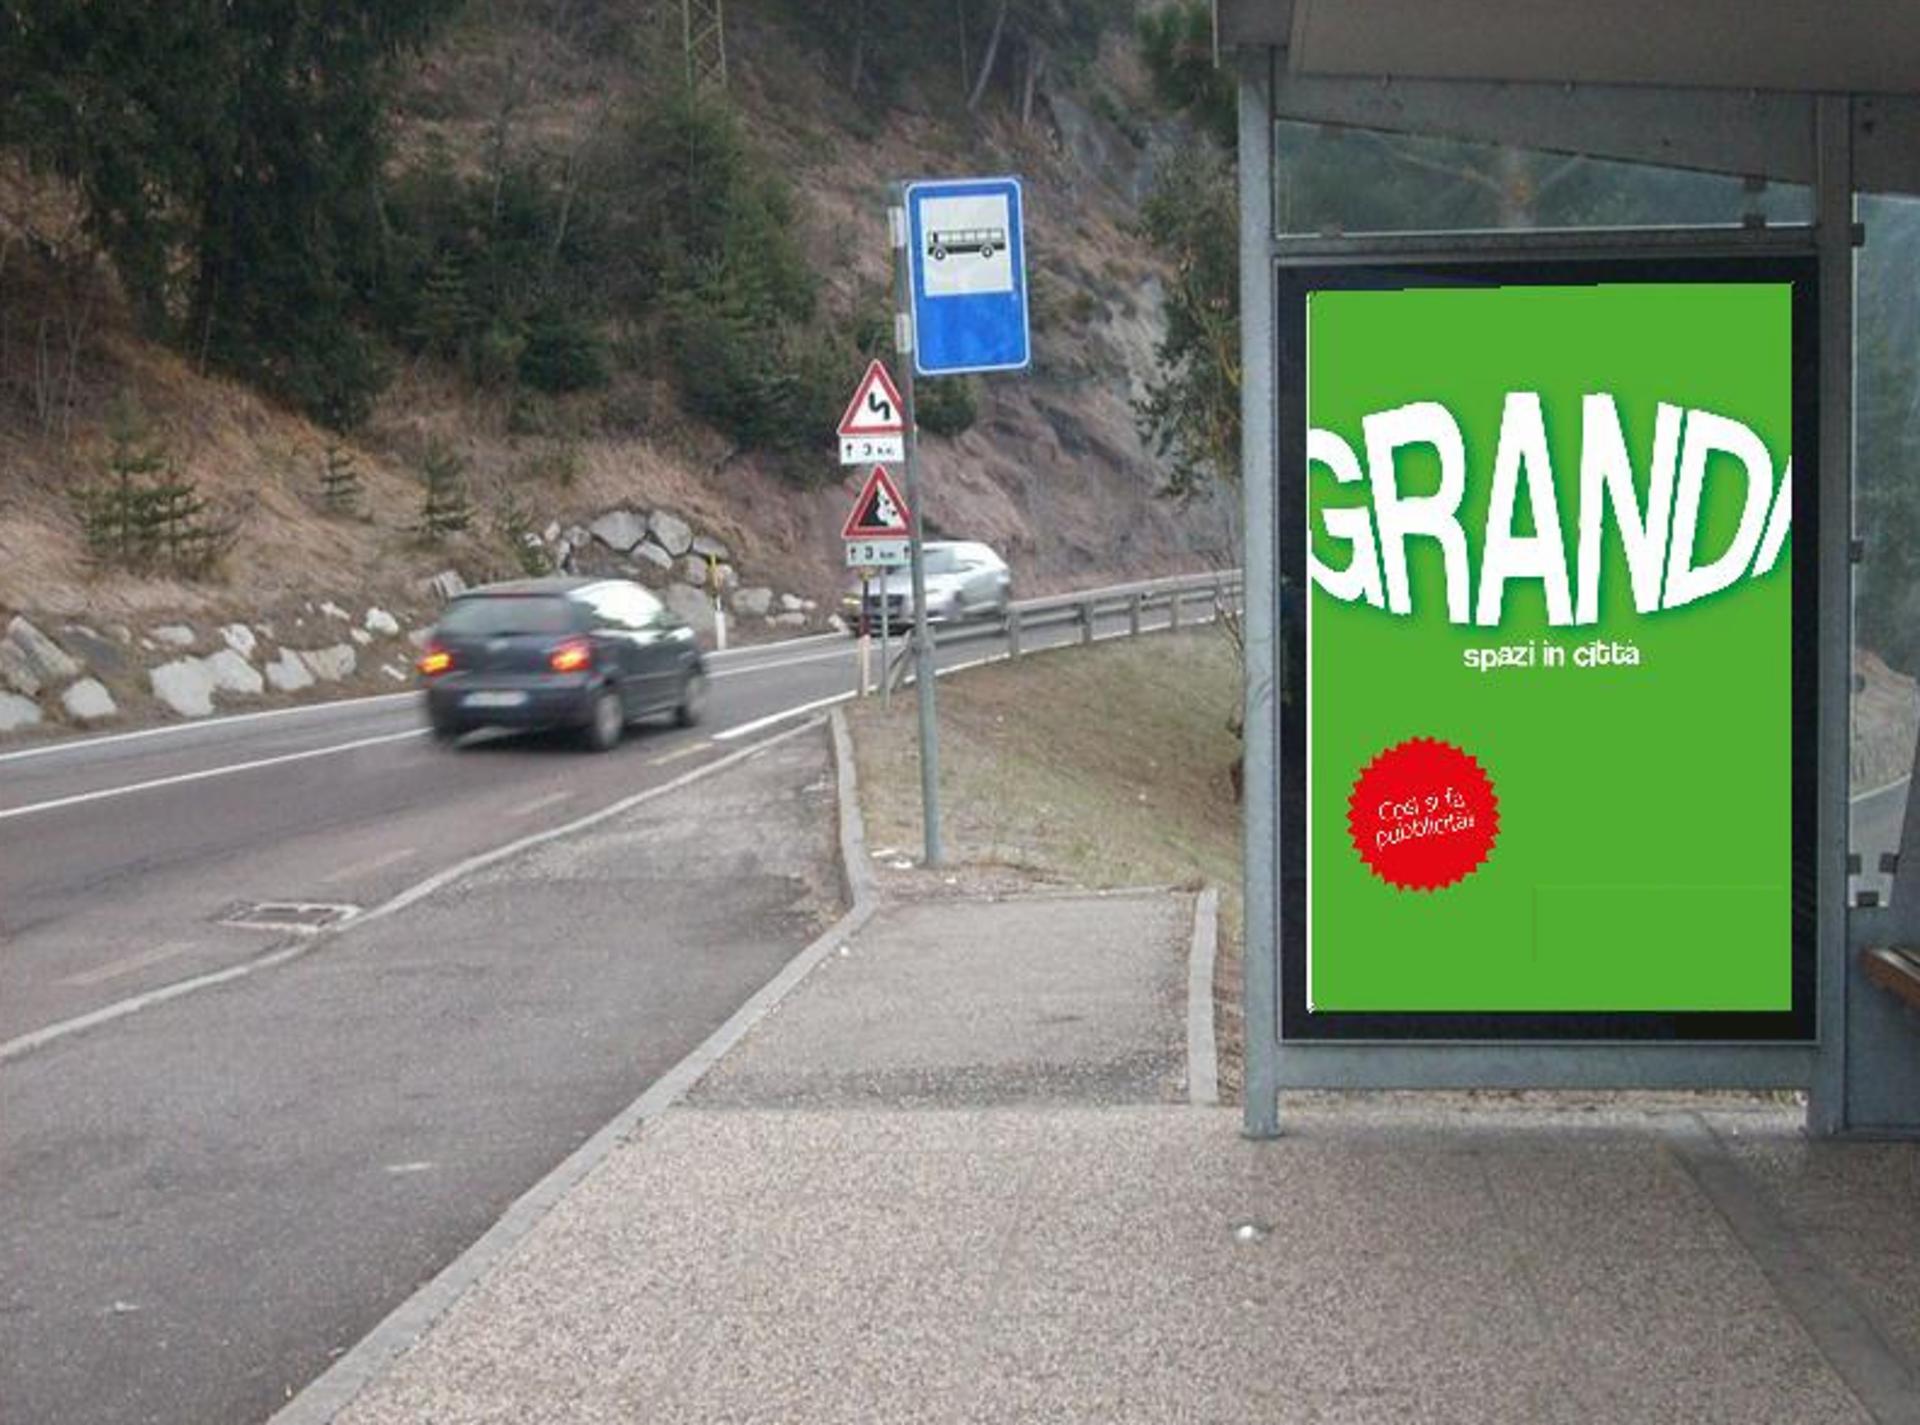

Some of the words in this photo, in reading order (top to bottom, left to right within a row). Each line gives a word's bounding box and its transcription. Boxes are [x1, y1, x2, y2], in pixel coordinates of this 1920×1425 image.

[865, 546, 874, 559] 3
[1463, 640, 1536, 672] spazi
[1543, 640, 1565, 667] in
